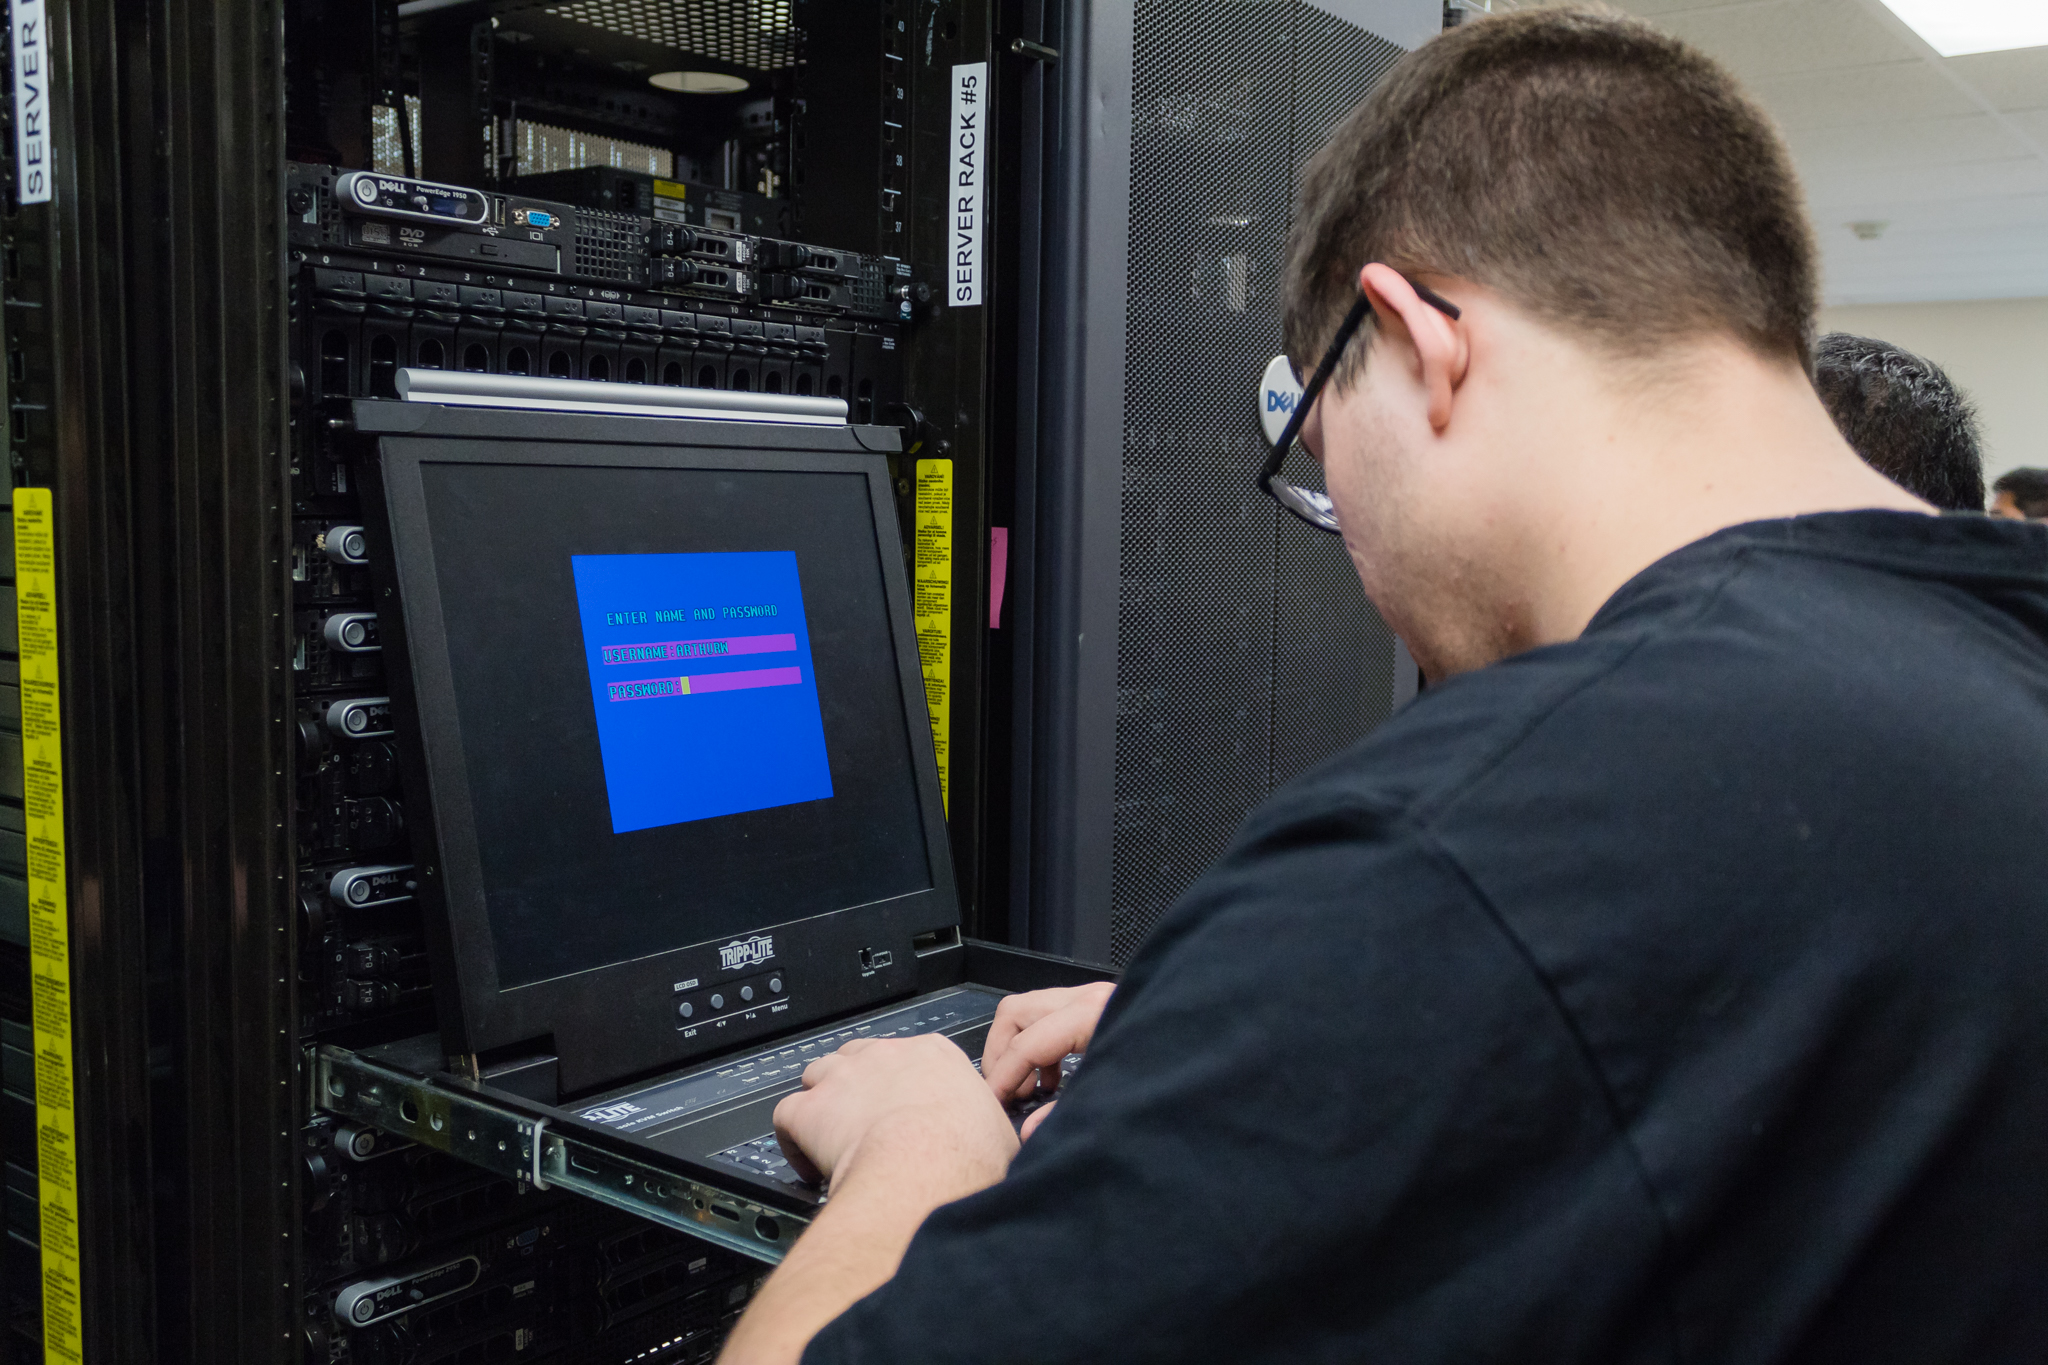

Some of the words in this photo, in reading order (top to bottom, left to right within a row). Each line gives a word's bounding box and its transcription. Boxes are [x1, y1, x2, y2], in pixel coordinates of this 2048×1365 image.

[960, 75, 977, 105] #5
[22, 20, 44, 195] SERVER
[958, 111, 976, 187] RACK
[379, 179, 407, 194] DELL
[416, 185, 451, 198] PowerEdge
[452, 190, 467, 200] 1950
[400, 227, 425, 238] DVD
[956, 195, 974, 302] SERVER
[419, 267, 425, 275] 2
[464, 273, 470, 281] 3
[507, 278, 513, 287] 4
[607, 611, 648, 626] ENTER
[655, 609, 686, 623] NAME
[694, 607, 716, 621] AND
[722, 604, 778, 619] PASSWORD
[609, 680, 681, 699] PASSWORD:
[372, 873, 399, 887] DELL
[675, 982, 686, 990] LCD
[771, 1003, 789, 1014] Menu
[684, 1028, 697, 1038] Exit
[376, 1285, 403, 1302] DELL
